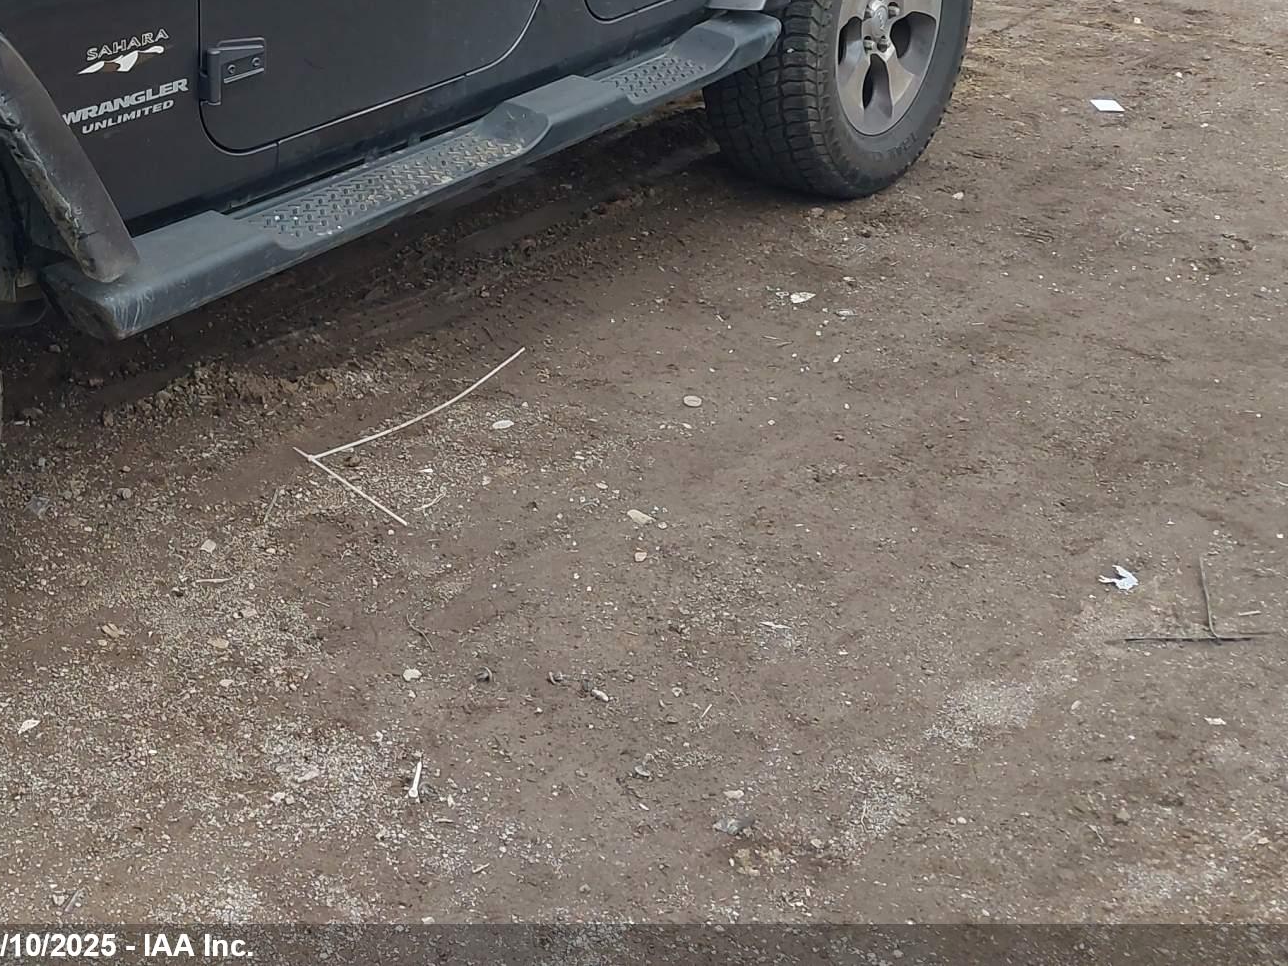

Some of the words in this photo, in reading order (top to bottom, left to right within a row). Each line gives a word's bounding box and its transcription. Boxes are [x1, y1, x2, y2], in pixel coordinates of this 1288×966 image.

[86, 28, 169, 61] SAHARA
[62, 78, 189, 125] WRANGLER
[82, 99, 174, 134] UNLIMITED
